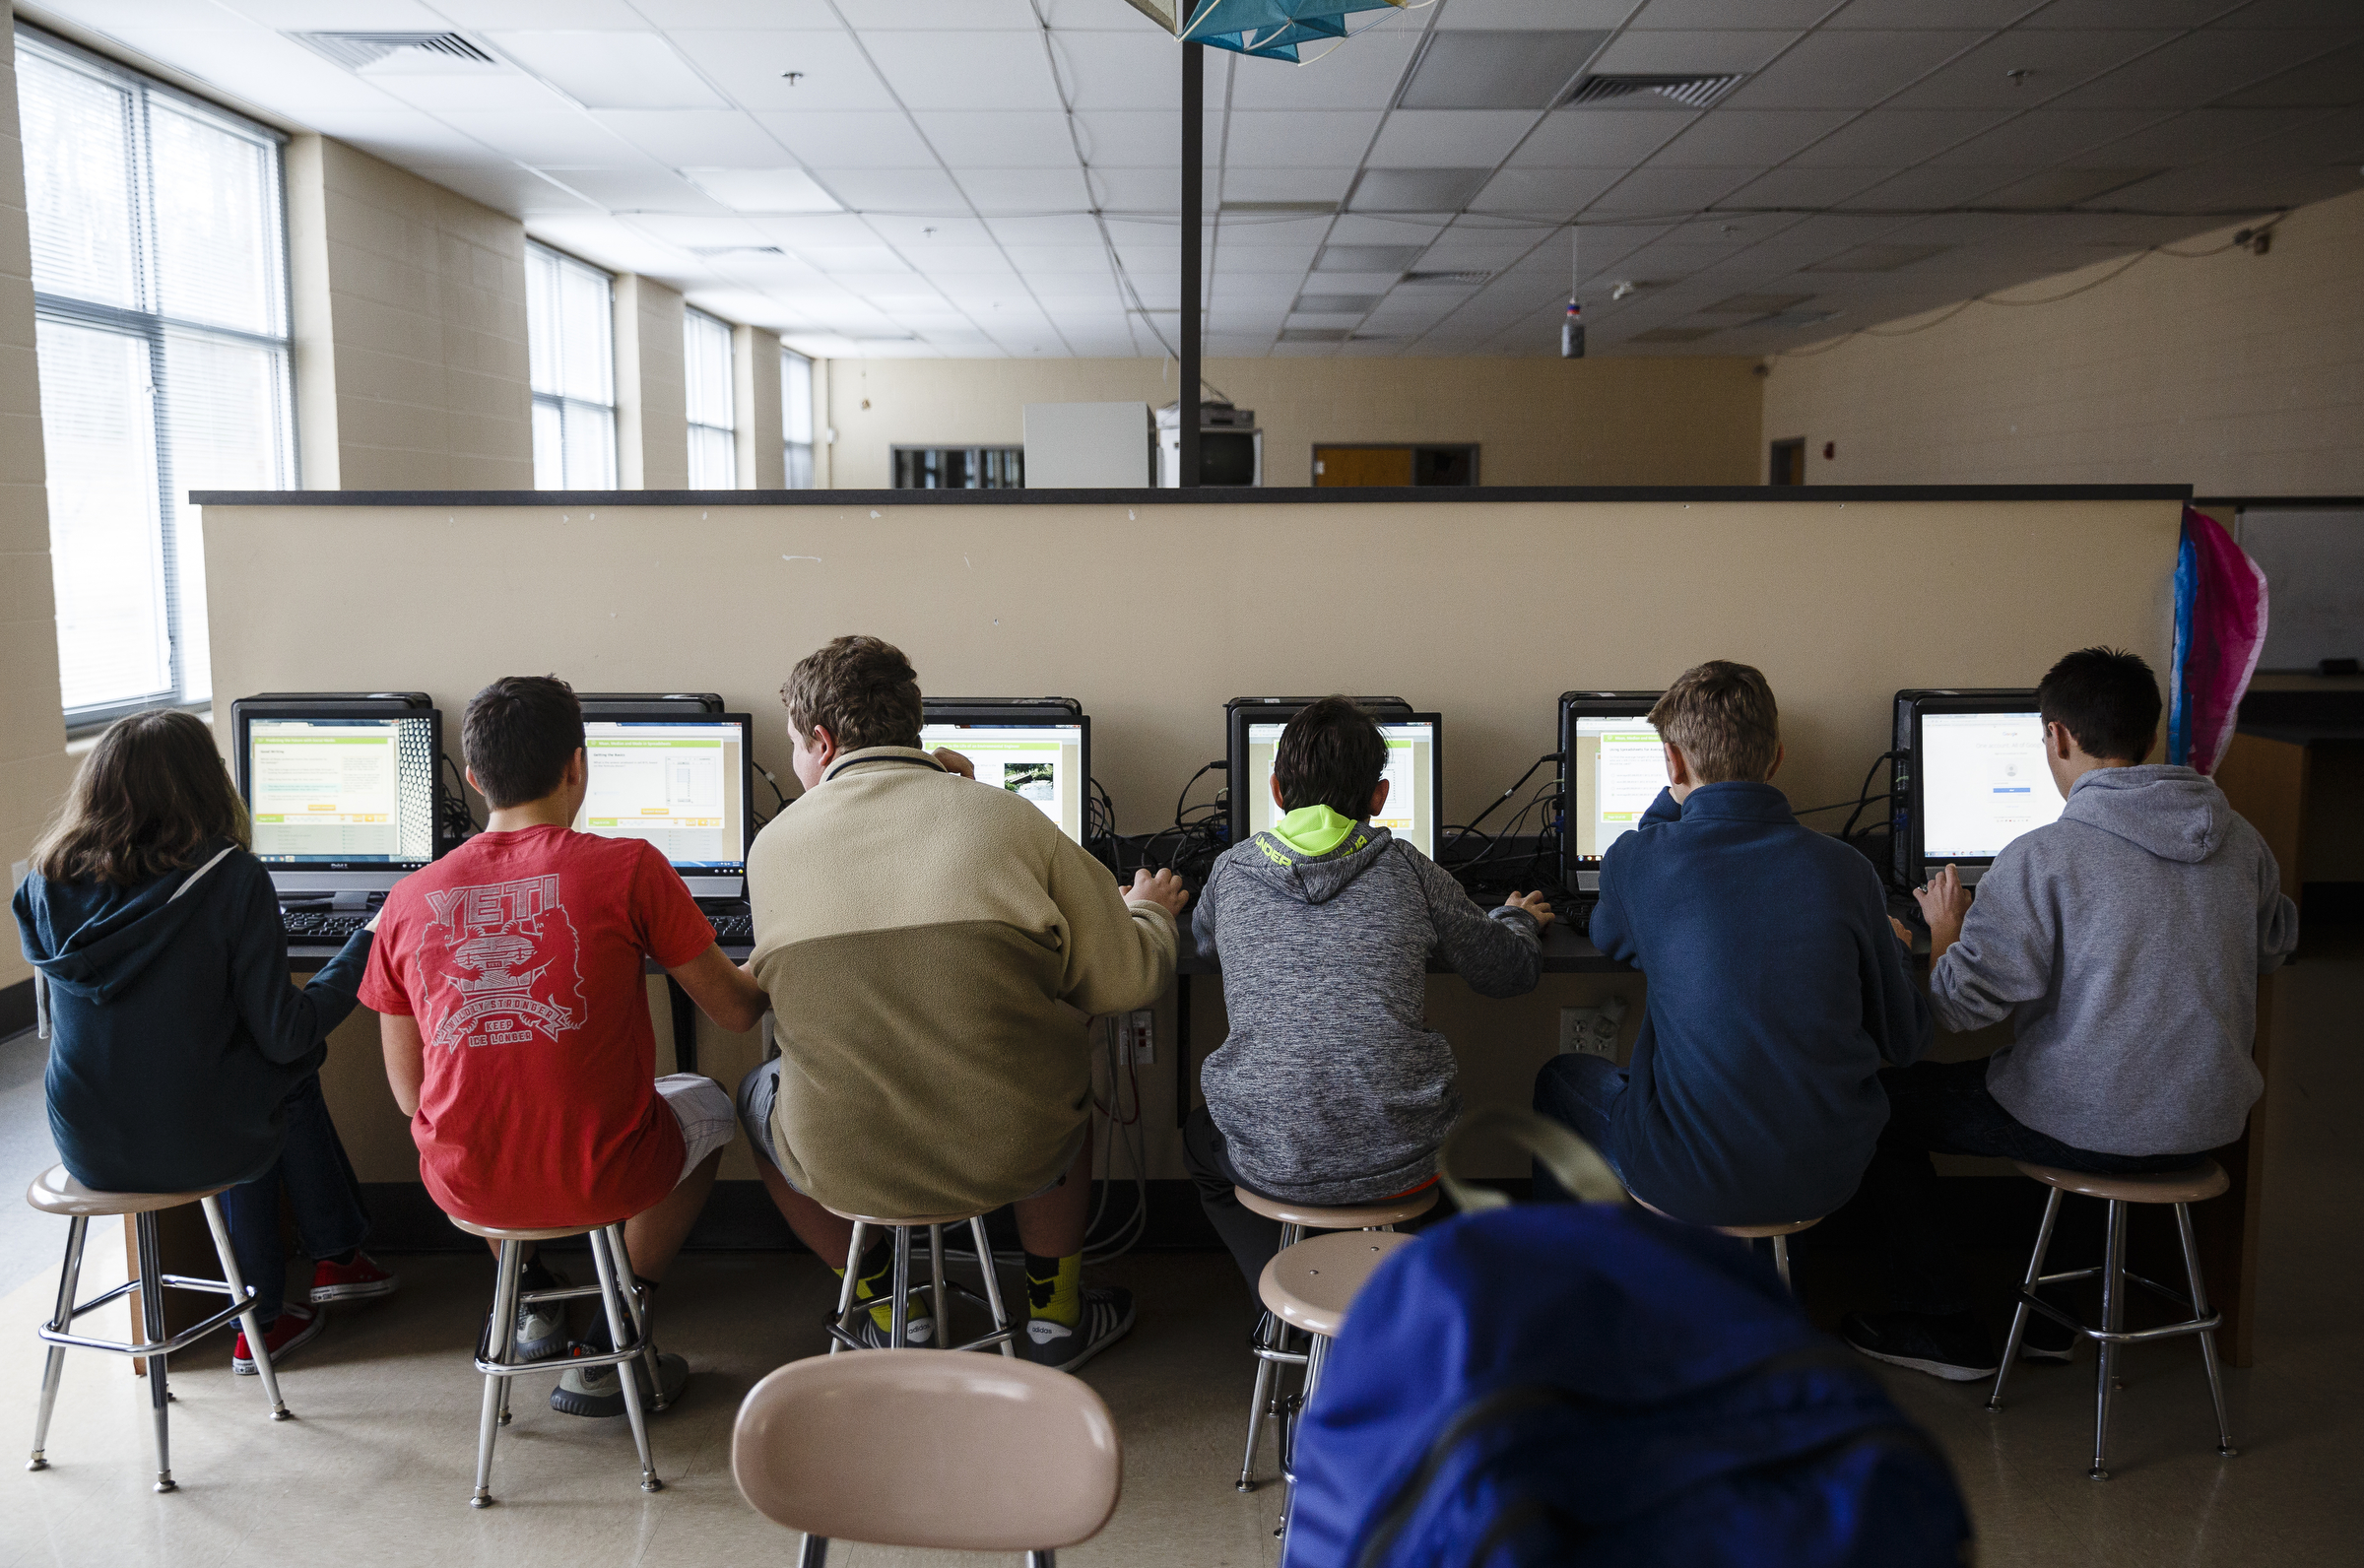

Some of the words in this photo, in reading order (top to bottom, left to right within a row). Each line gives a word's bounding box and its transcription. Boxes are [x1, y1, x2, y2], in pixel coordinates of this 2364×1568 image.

[425, 873, 559, 928] YETI
[446, 1002, 486, 1031] WILDLY
[491, 999, 554, 1019] STRONGER
[485, 1019, 513, 1032] KEEP
[469, 1034, 488, 1047] ICE
[491, 1030, 533, 1045] LONGER
[908, 1323, 931, 1335] adidas
[1032, 1326, 1053, 1335] adidas
